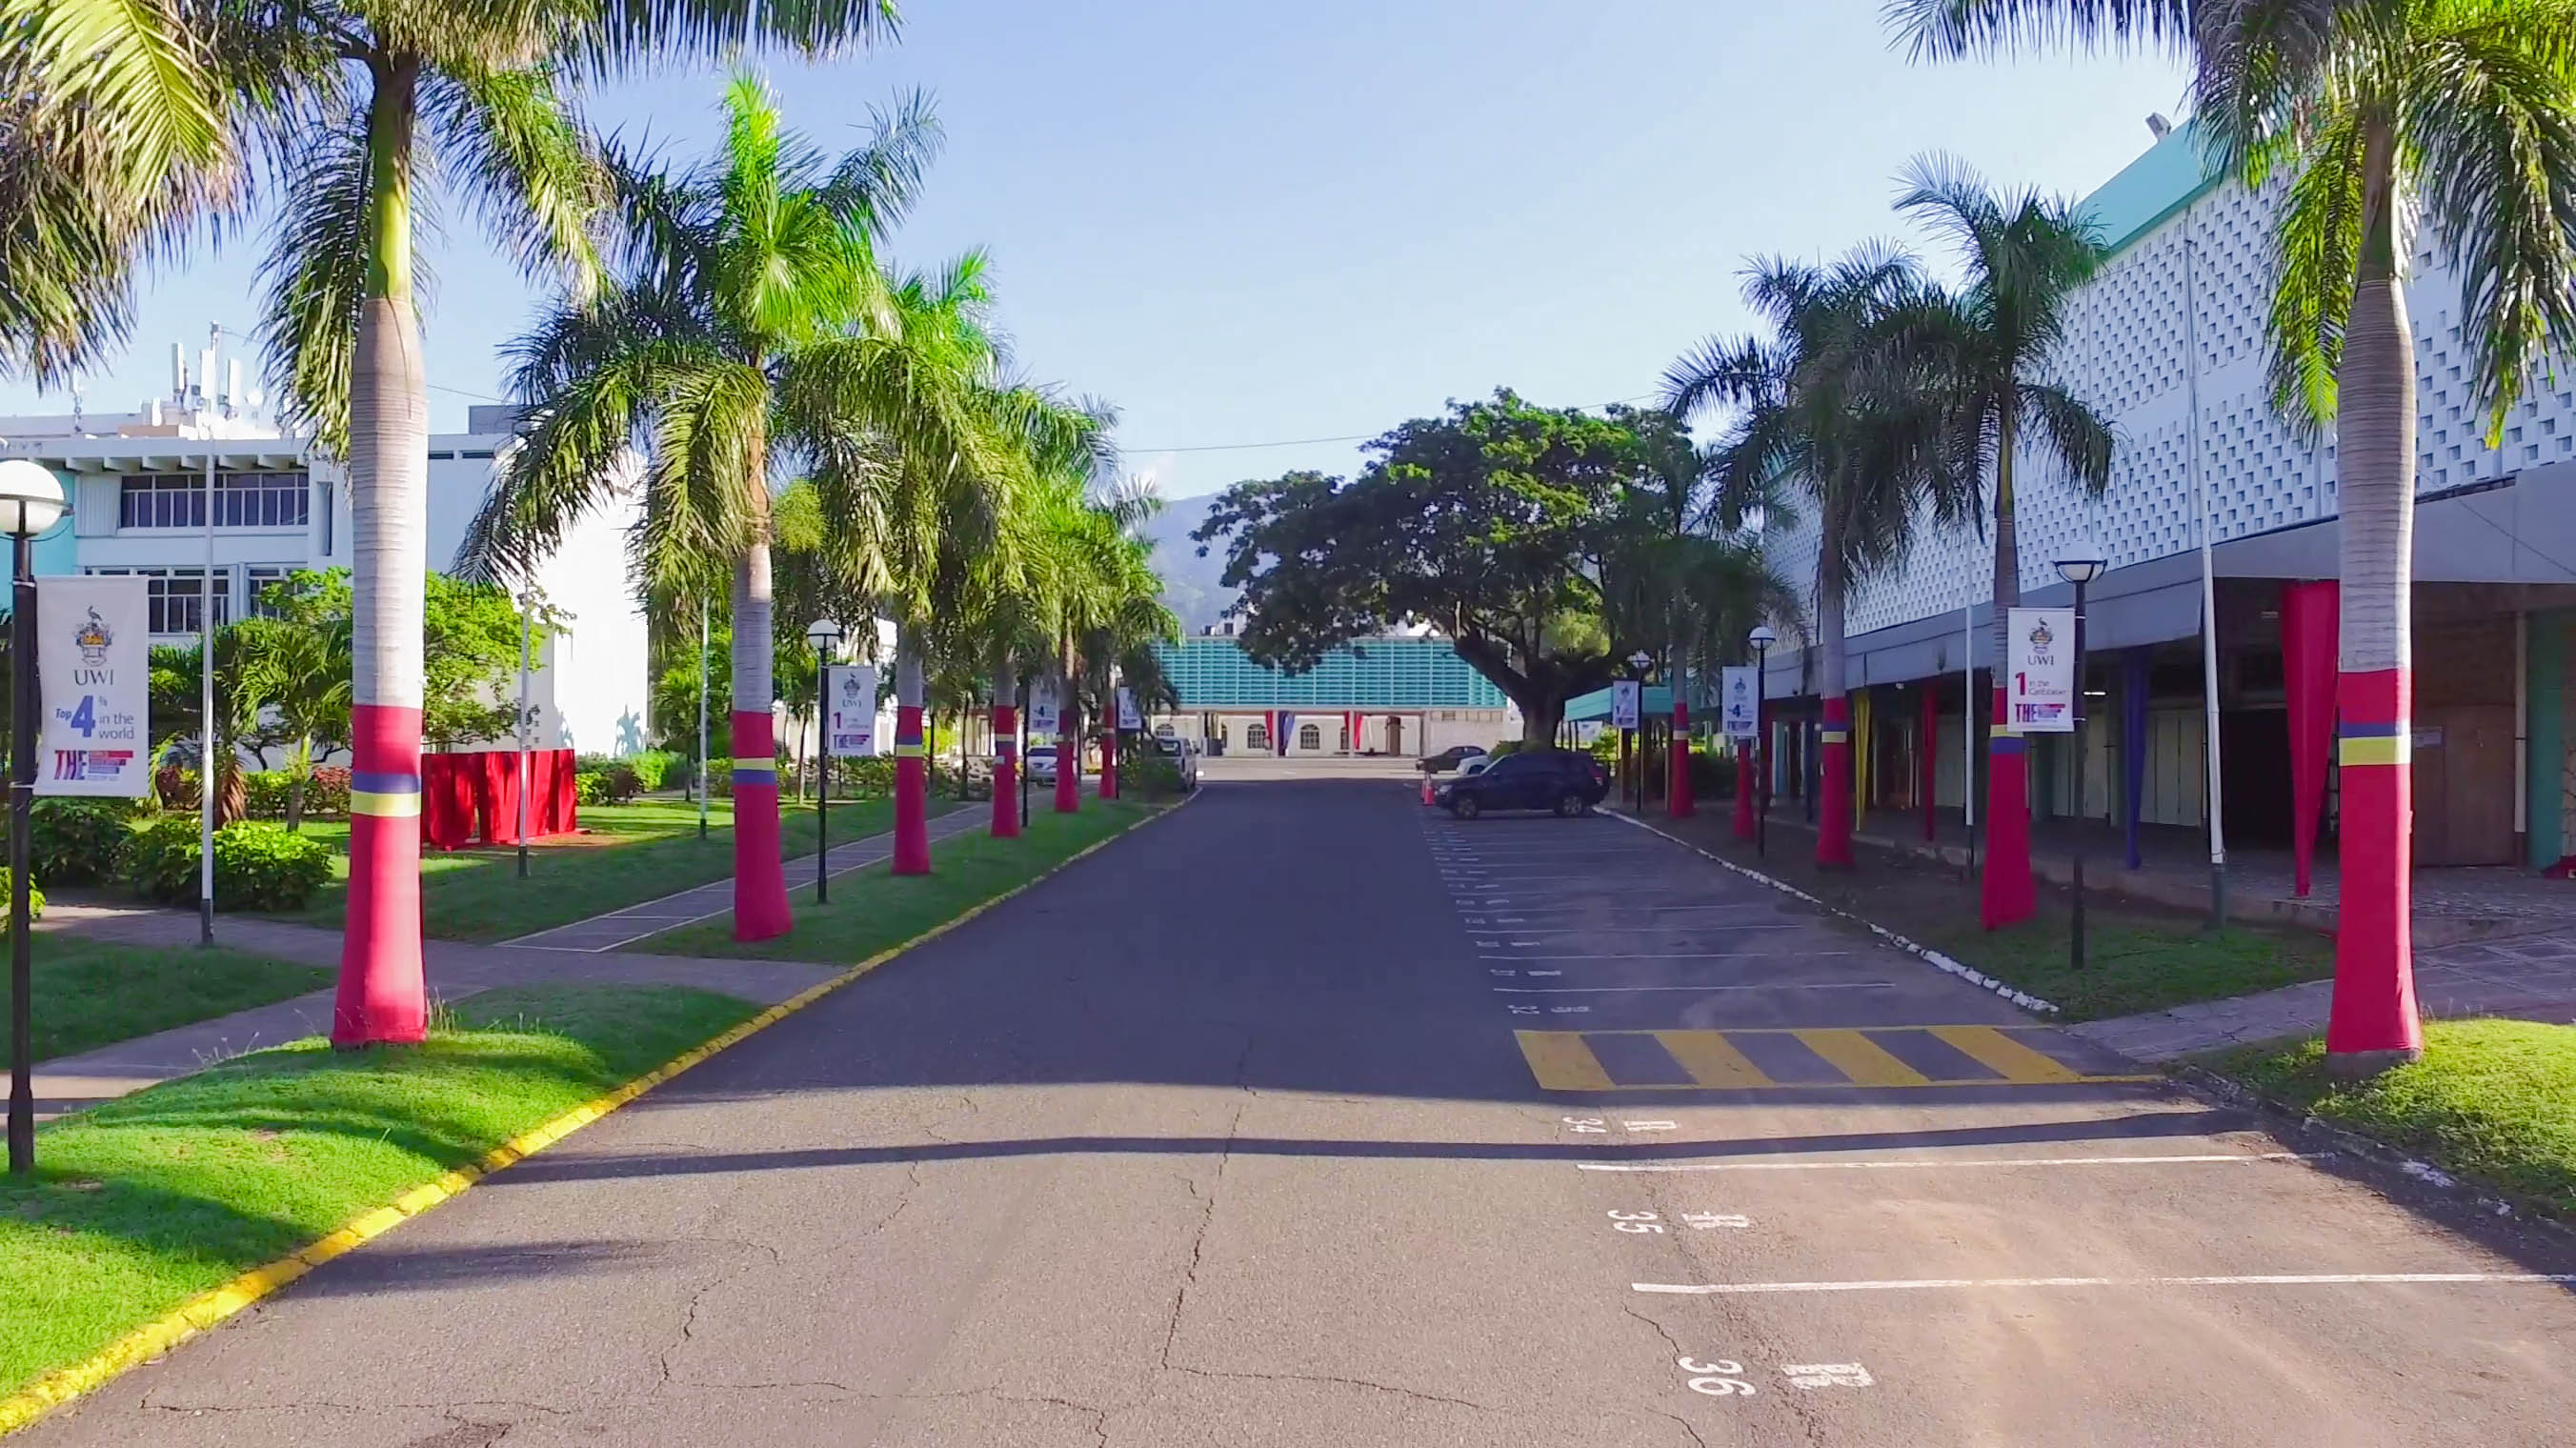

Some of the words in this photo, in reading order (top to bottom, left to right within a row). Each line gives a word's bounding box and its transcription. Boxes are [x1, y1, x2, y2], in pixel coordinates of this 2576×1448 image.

[2027, 654, 2054, 666] UWI
[73, 669, 114, 686] UWI
[2015, 672, 2025, 695] 1
[55, 708, 72, 721] Top
[70, 695, 95, 737] 4
[113, 713, 134, 725] the
[2015, 703, 2038, 723] THE
[98, 727, 134, 740] world
[54, 750, 87, 780] THE
[1562, 1116, 1608, 1134] 34
[1607, 1209, 1663, 1234] 35
[1679, 1357, 1757, 1397] 36
